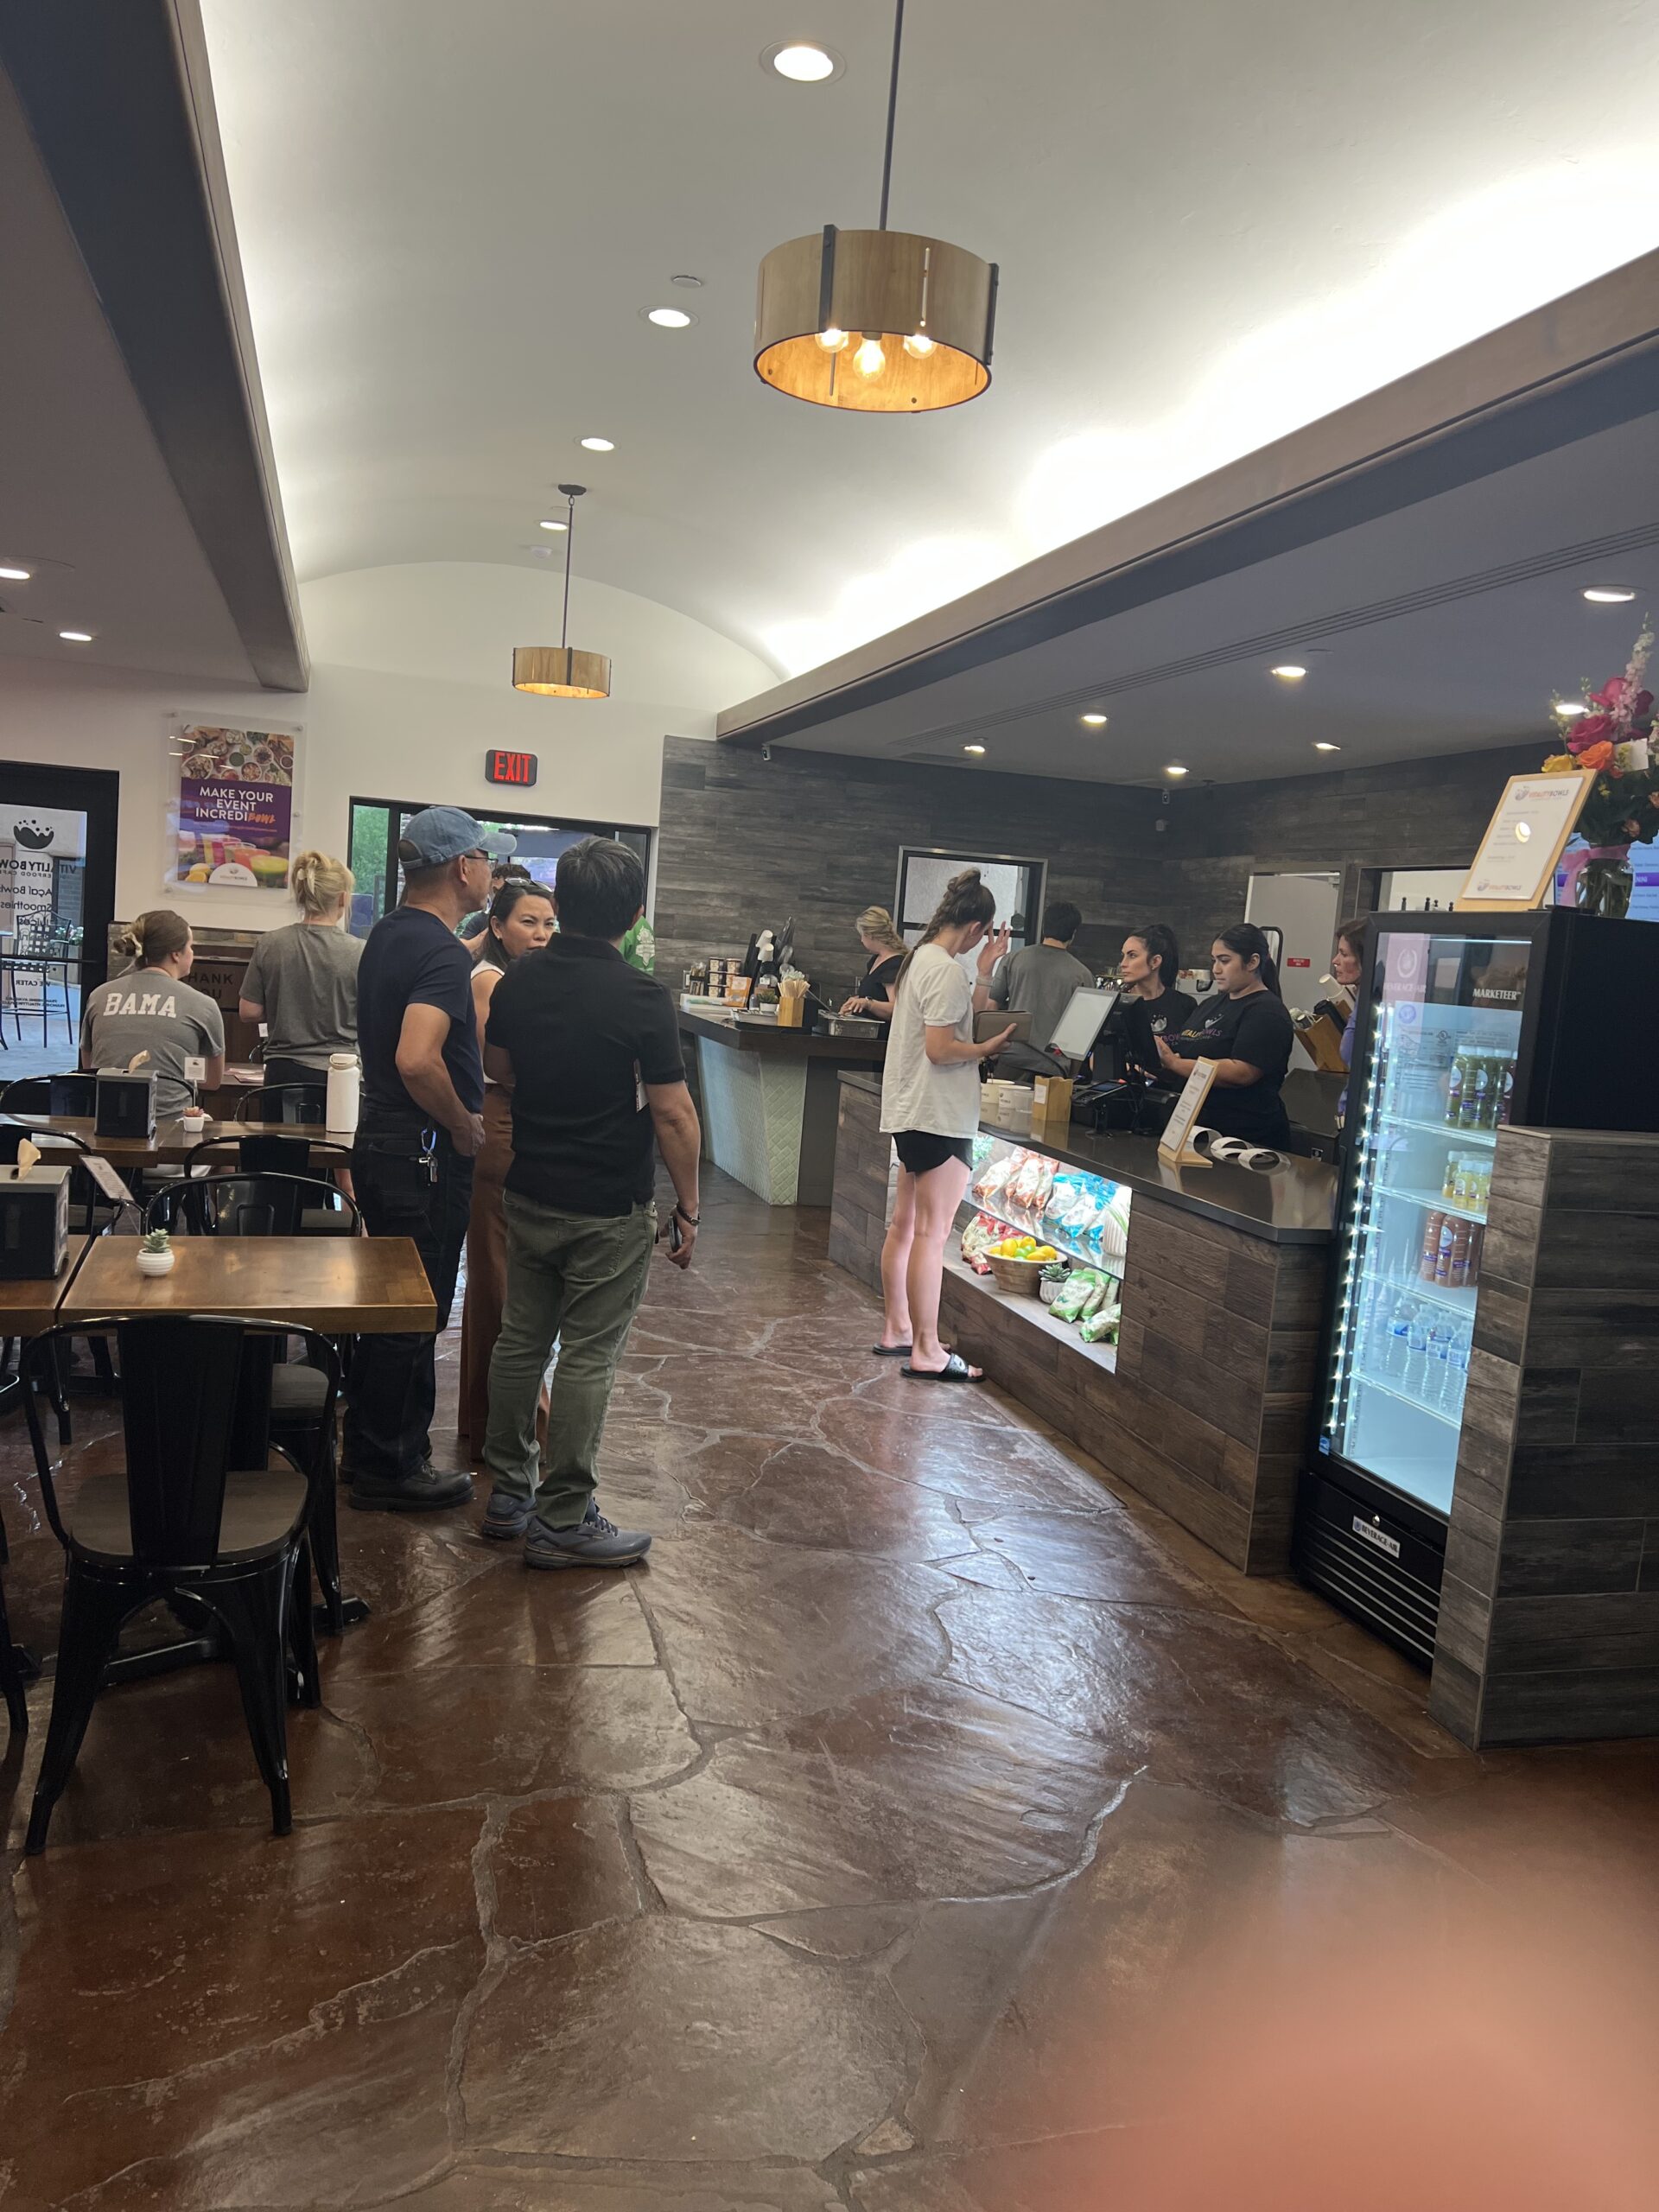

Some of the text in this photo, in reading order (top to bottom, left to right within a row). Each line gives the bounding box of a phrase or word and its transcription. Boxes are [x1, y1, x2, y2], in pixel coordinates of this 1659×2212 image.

[494, 751, 532, 783] EXIT
[199, 786, 274, 803] MAKE YOUR
[216, 799, 257, 811] EVENT
[188, 972, 233, 985] HANK
[201, 988, 222, 1000] OU
[103, 993, 176, 1018] BAMA
